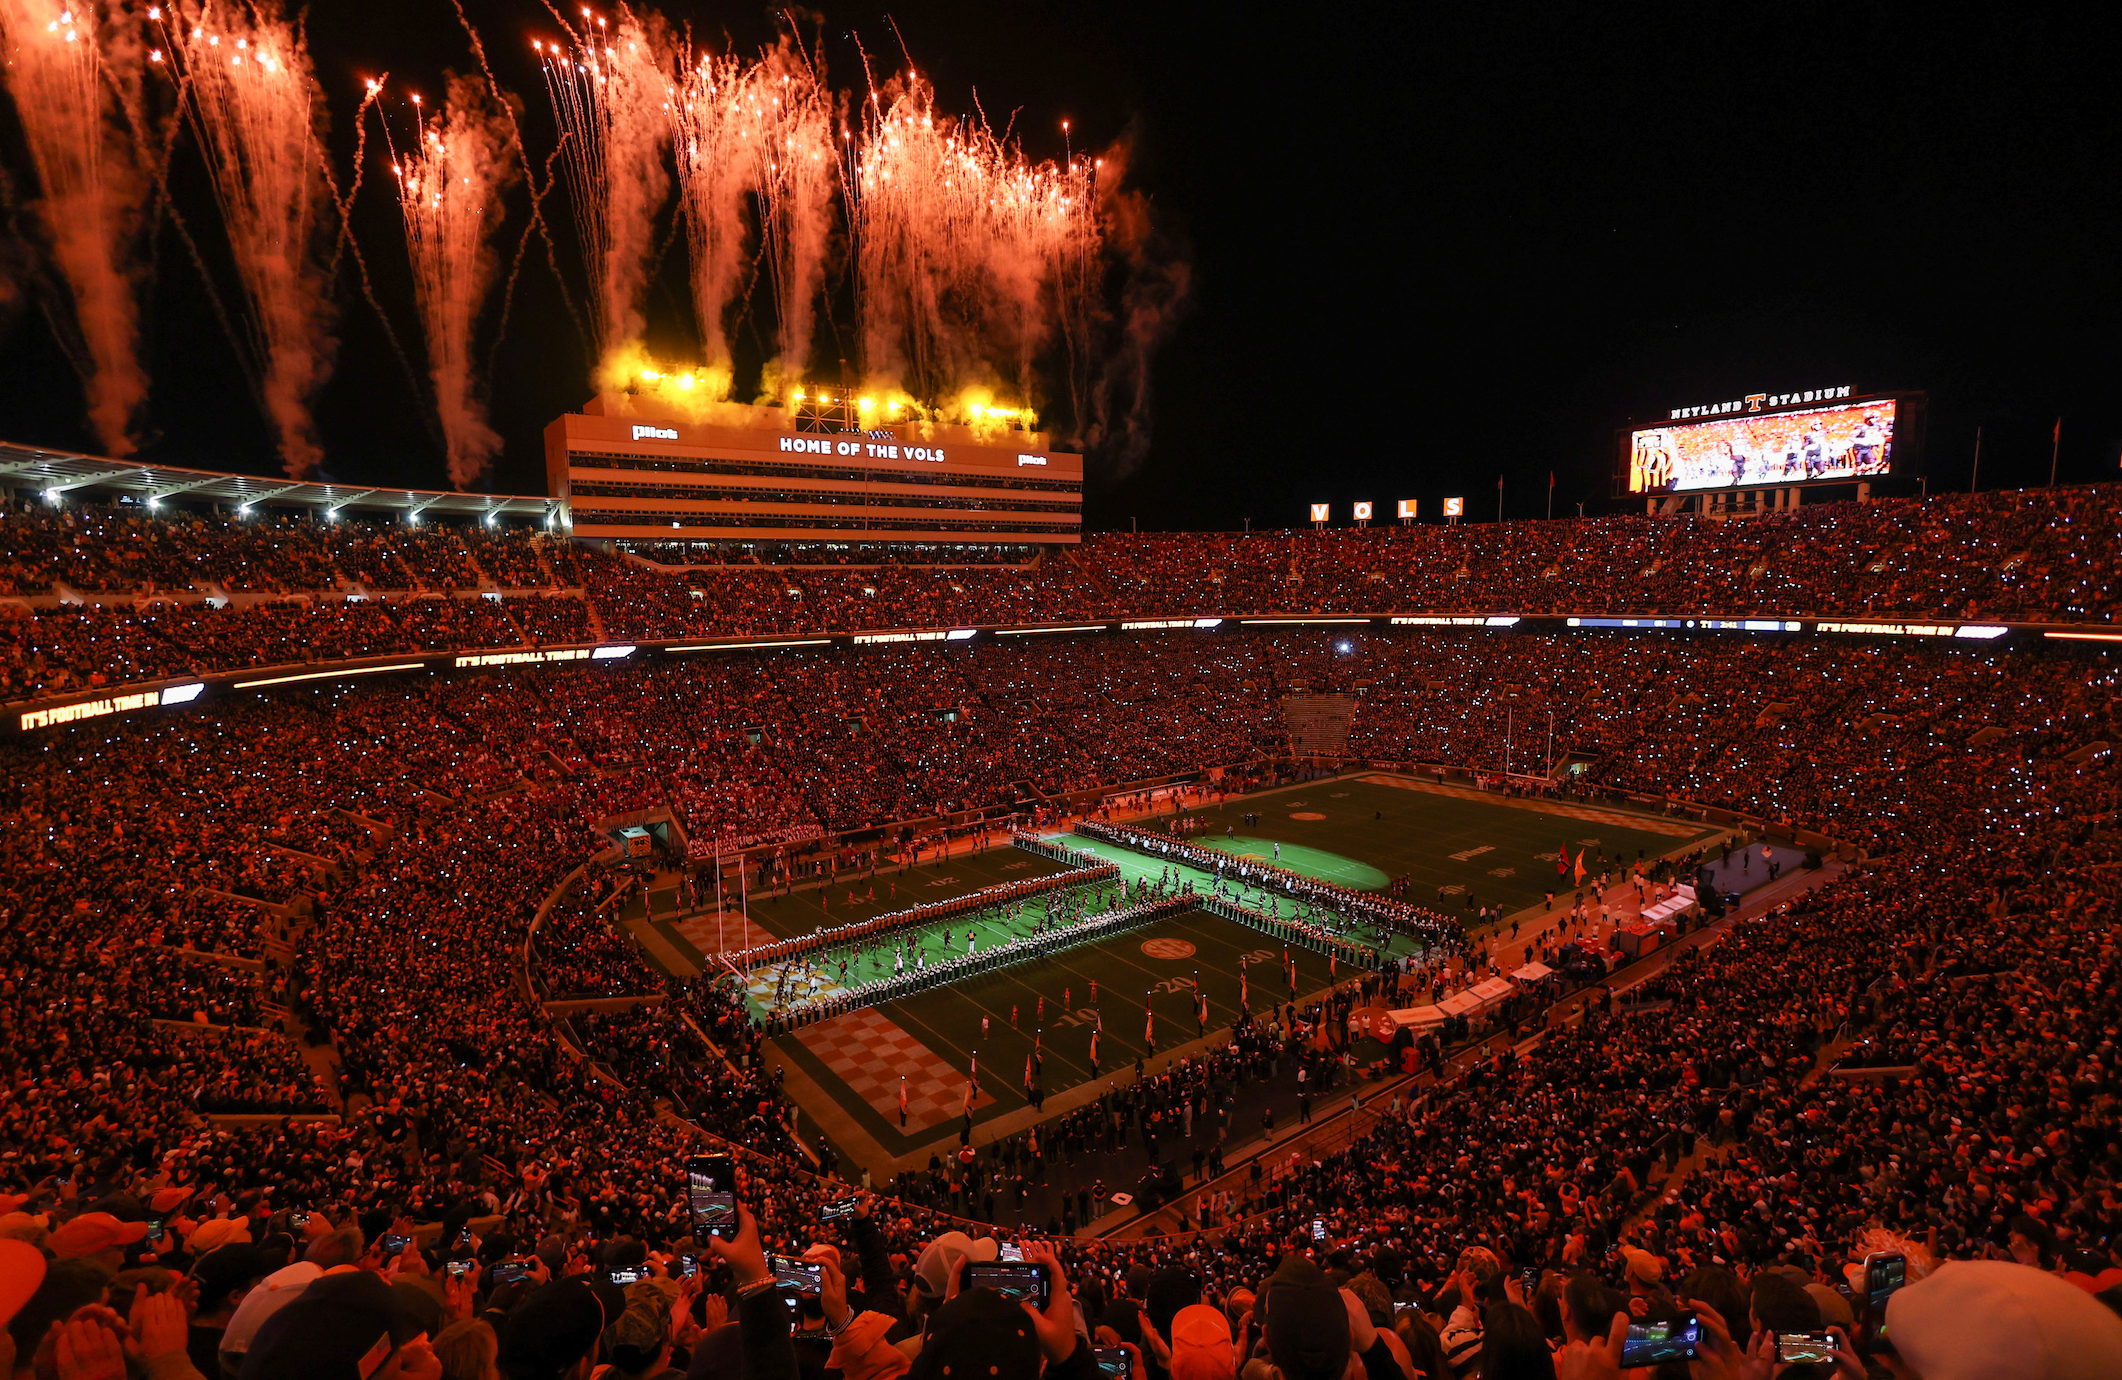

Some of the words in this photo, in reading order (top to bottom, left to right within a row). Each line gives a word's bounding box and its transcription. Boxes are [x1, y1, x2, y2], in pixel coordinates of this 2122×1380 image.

[1671, 401, 1742, 419] NEYLAND
[1769, 386, 1851, 407] STADIUM
[780, 438, 831, 455] HOME
[837, 442, 860, 457] OF
[866, 444, 898, 459] THE
[903, 447, 944, 462] VOLS
[1841, 624, 1904, 634] FOOTBALL
[456, 656, 480, 667] IT'S
[481, 652, 545, 666] FOOTBALL
[546, 650, 575, 661] TIME
[576, 649, 589, 659] IN
[21, 710, 48, 730] IT'S
[49, 700, 113, 725] FOOTBALL
[113, 694, 143, 712] TIME
[144, 692, 159, 707] IN
